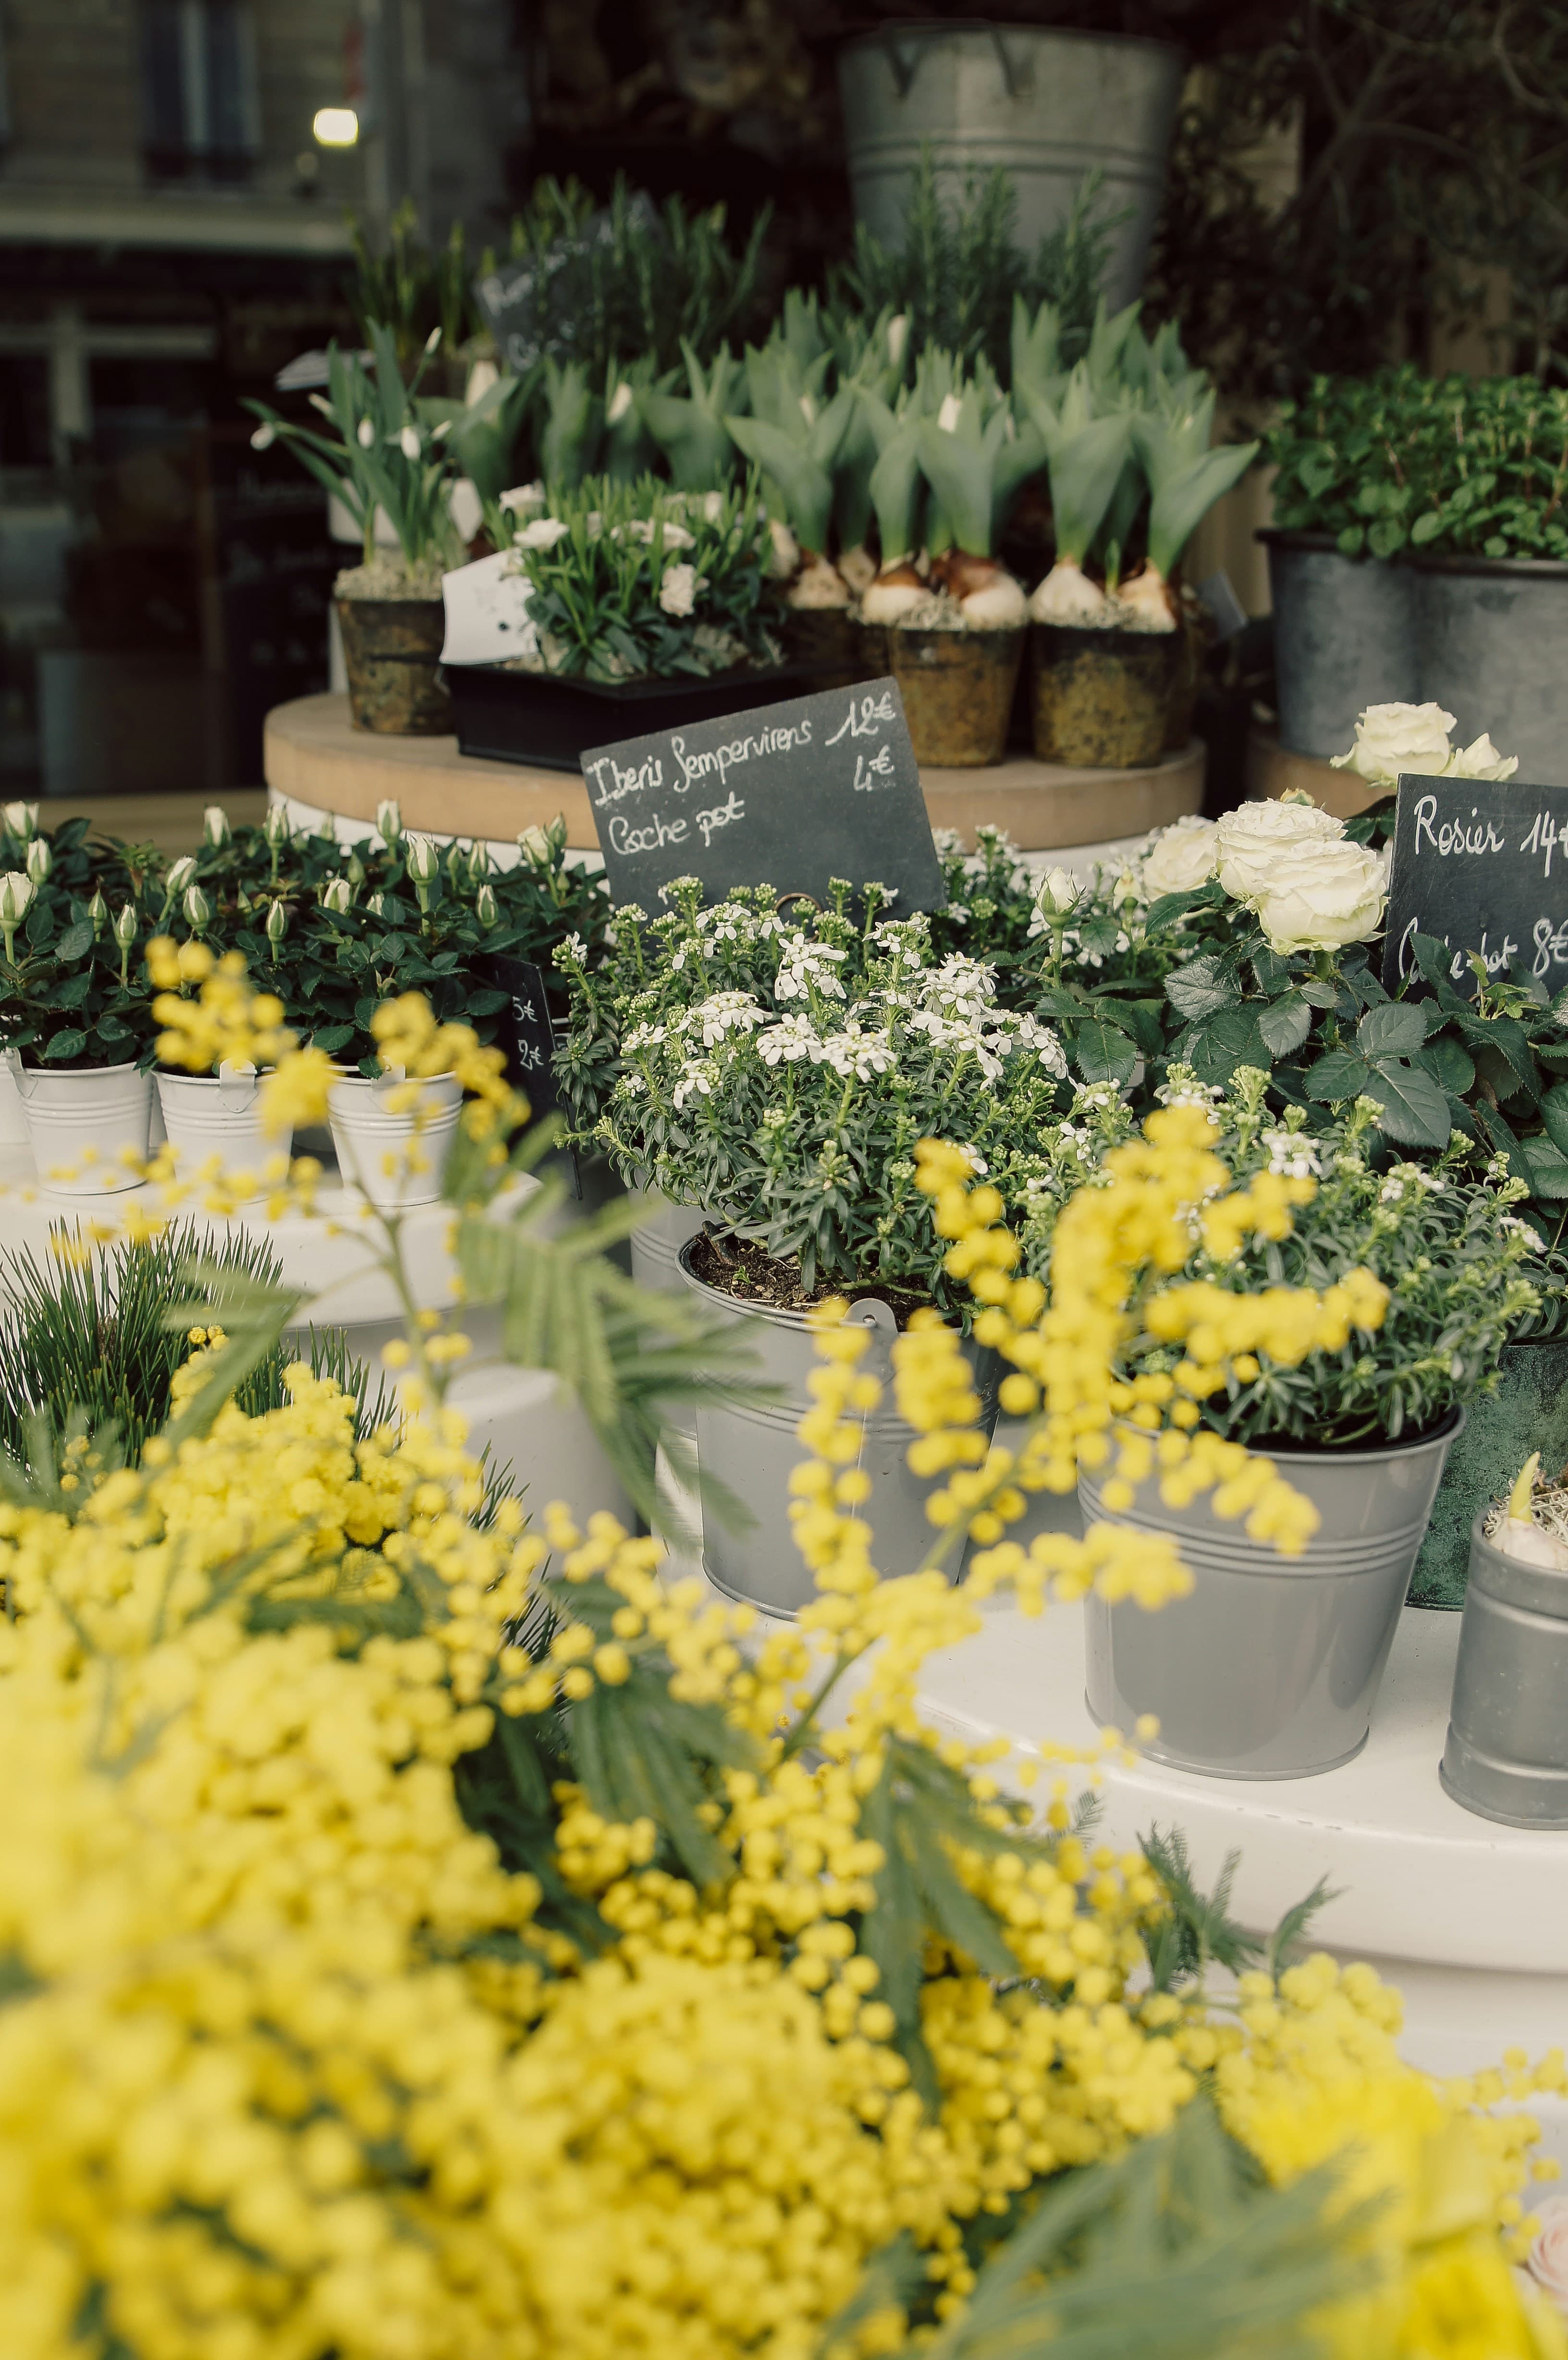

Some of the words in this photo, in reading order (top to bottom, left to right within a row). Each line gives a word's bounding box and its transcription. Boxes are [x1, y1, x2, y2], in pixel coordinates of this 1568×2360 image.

[587, 755, 663, 807] Iberis
[671, 719, 812, 793] Sempervirens
[824, 691, 896, 747] 12€
[853, 744, 895, 792] 4€
[695, 790, 746, 848] pot
[1414, 795, 1505, 856] Rosier
[1532, 917, 1568, 979] 8€
[512, 996, 538, 1022] 5€
[518, 1039, 544, 1070] 2€
